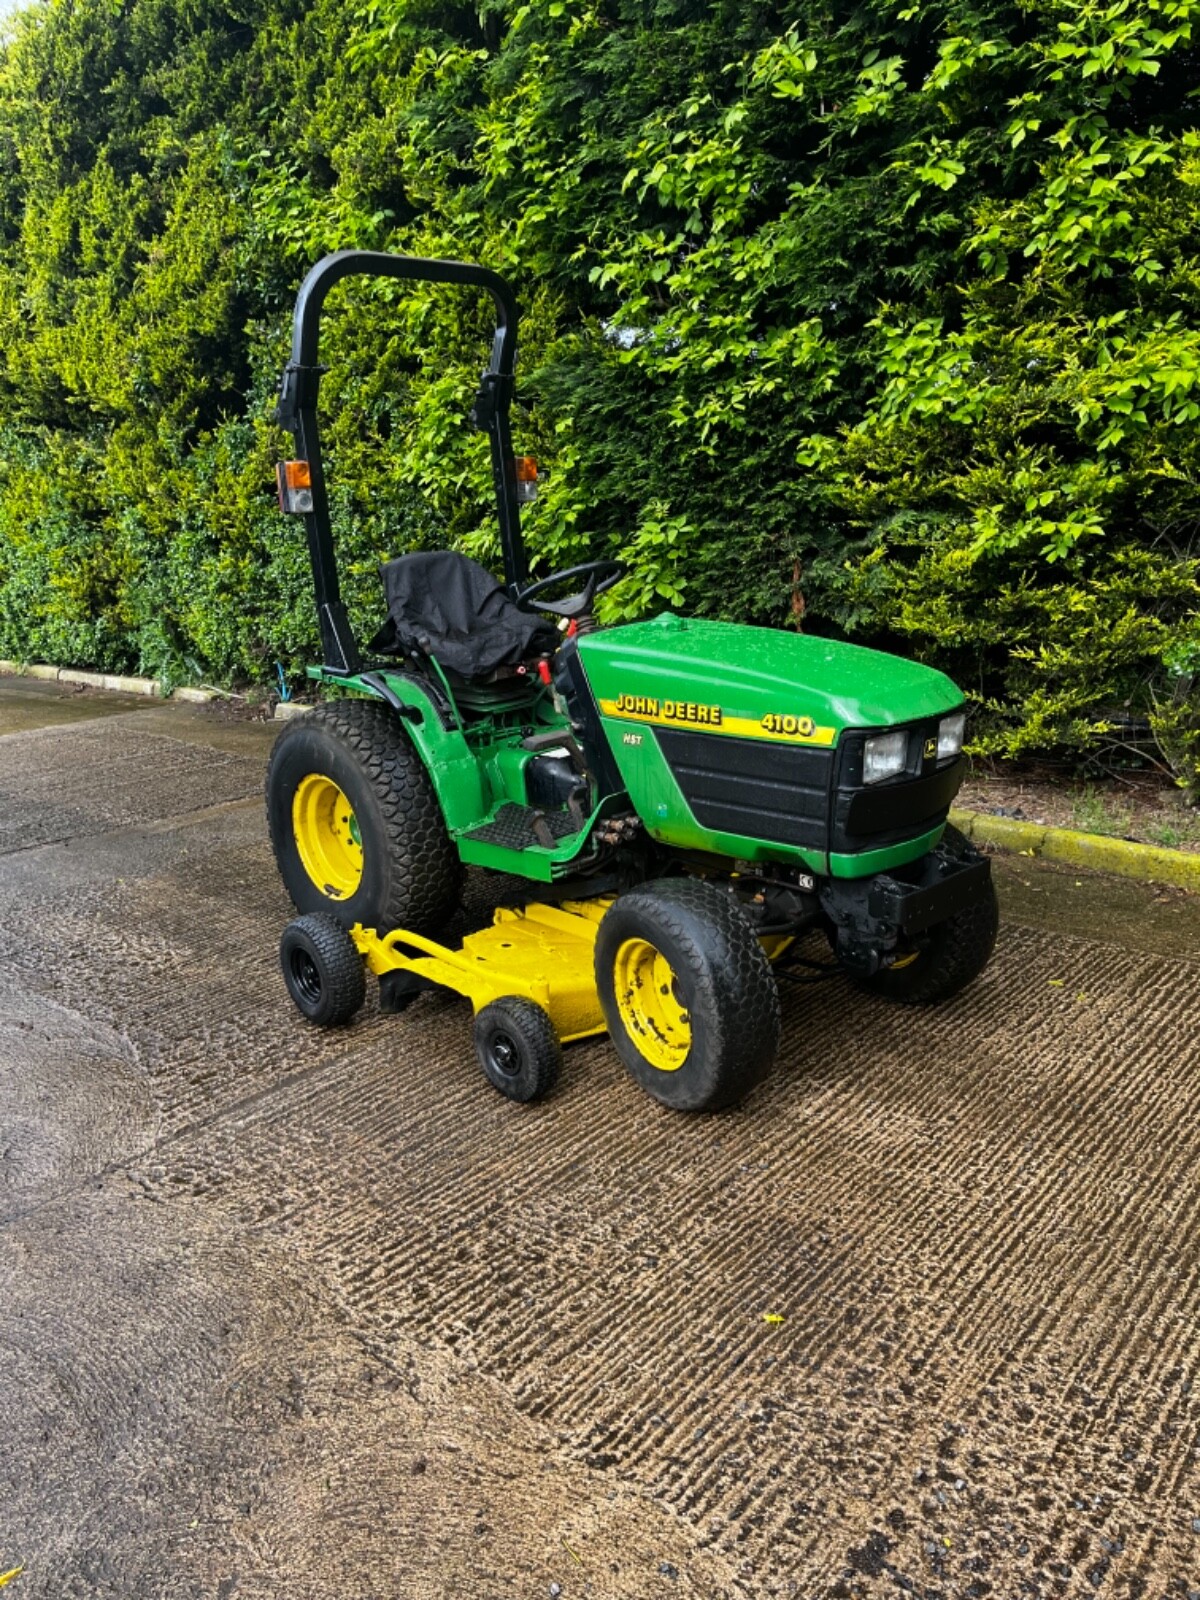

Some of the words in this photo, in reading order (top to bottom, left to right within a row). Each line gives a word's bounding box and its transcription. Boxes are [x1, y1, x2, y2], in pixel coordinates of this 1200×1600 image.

[616, 693, 659, 716] JOHN
[664, 700, 722, 725] DEERE
[761, 713, 815, 737] 4100
[623, 732, 643, 745] HST
